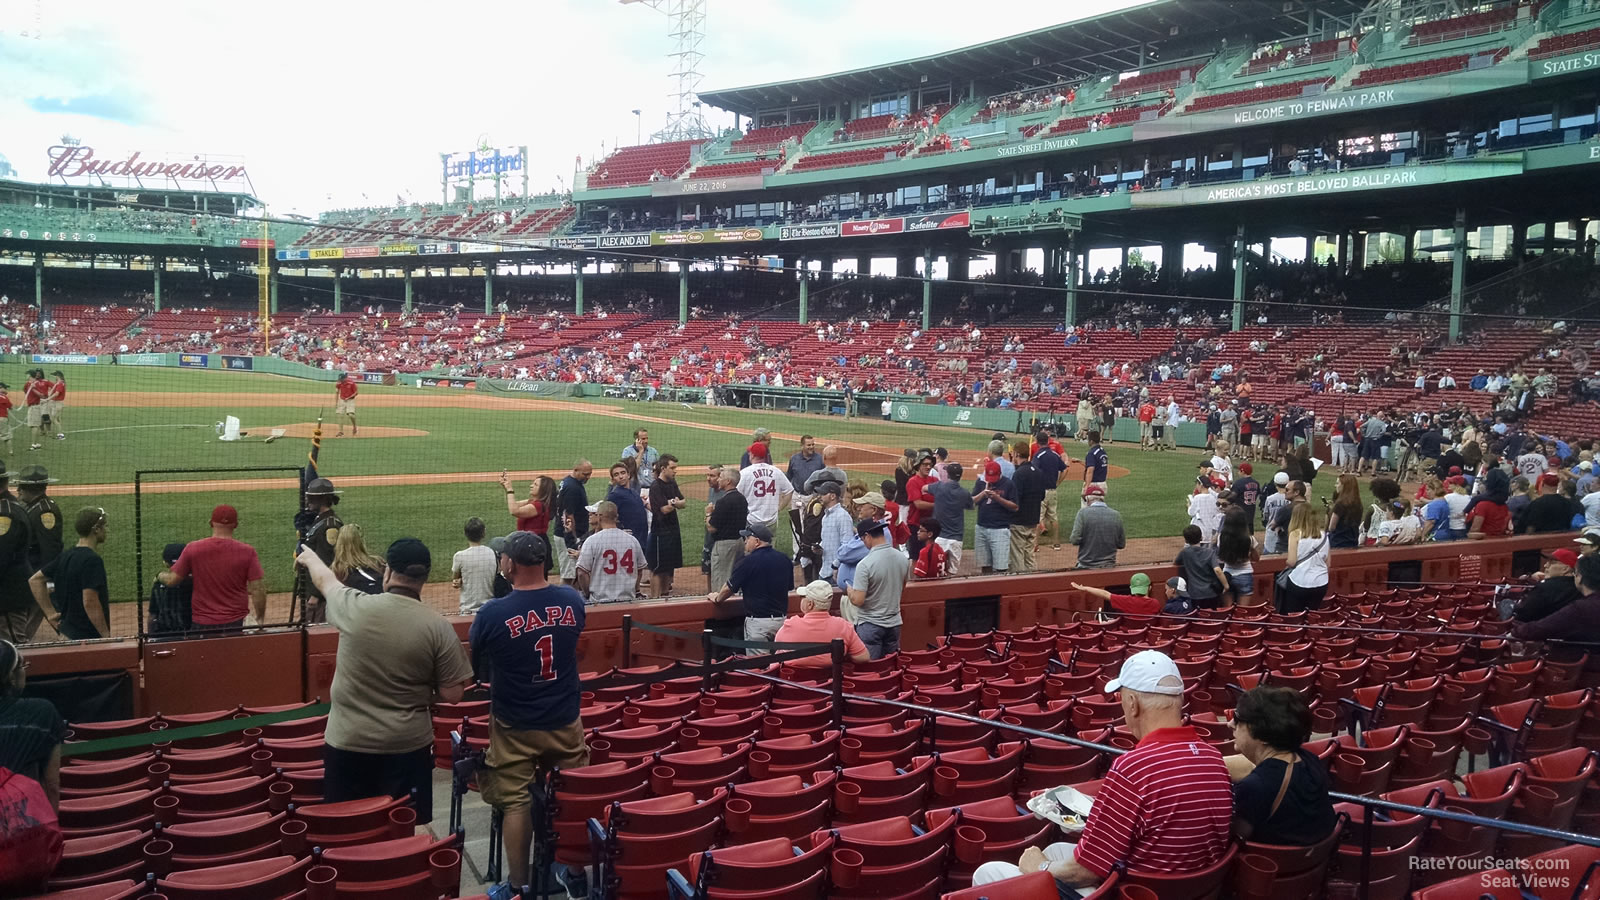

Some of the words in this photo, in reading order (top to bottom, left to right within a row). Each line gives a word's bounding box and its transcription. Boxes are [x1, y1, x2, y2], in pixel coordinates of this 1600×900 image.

[1543, 57, 1582, 75] STATE
[1234, 105, 1285, 124] WELCOME
[1289, 103, 1303, 116] TO
[1307, 96, 1357, 113] FENWAY
[1360, 90, 1394, 105] PARK
[997, 147, 1018, 157] STATE
[1018, 143, 1043, 154] STREET
[1044, 137, 1079, 150] PAVILION
[47, 145, 245, 180] Budweiser
[682, 183, 698, 192] JUNE
[699, 182, 710, 192] 22,
[1207, 185, 1261, 201] AMERICA'S
[1264, 182, 1294, 195] MOST
[1297, 177, 1349, 192] BELOVED
[1352, 170, 1417, 187] BALLPARK
[791, 227, 801, 238] The
[801, 226, 821, 237] Boston
[821, 224, 837, 236] Globe
[852, 224, 870, 232] Ninety
[878, 222, 890, 230] Nine
[909, 222, 938, 230] Safelite
[602, 237, 618, 246] ALEX
[620, 236, 635, 246] AND
[636, 235, 649, 245] ANI
[315, 249, 339, 258] STANLEY
[507, 381, 539, 392] L.L.Bean
[752, 468, 774, 479] ORTIZ
[1526, 463, 1536, 475] 2
[753, 479, 777, 498] 34
[602, 548, 634, 575] 34
[505, 605, 577, 639] PAPA
[532, 634, 558, 683] 1
